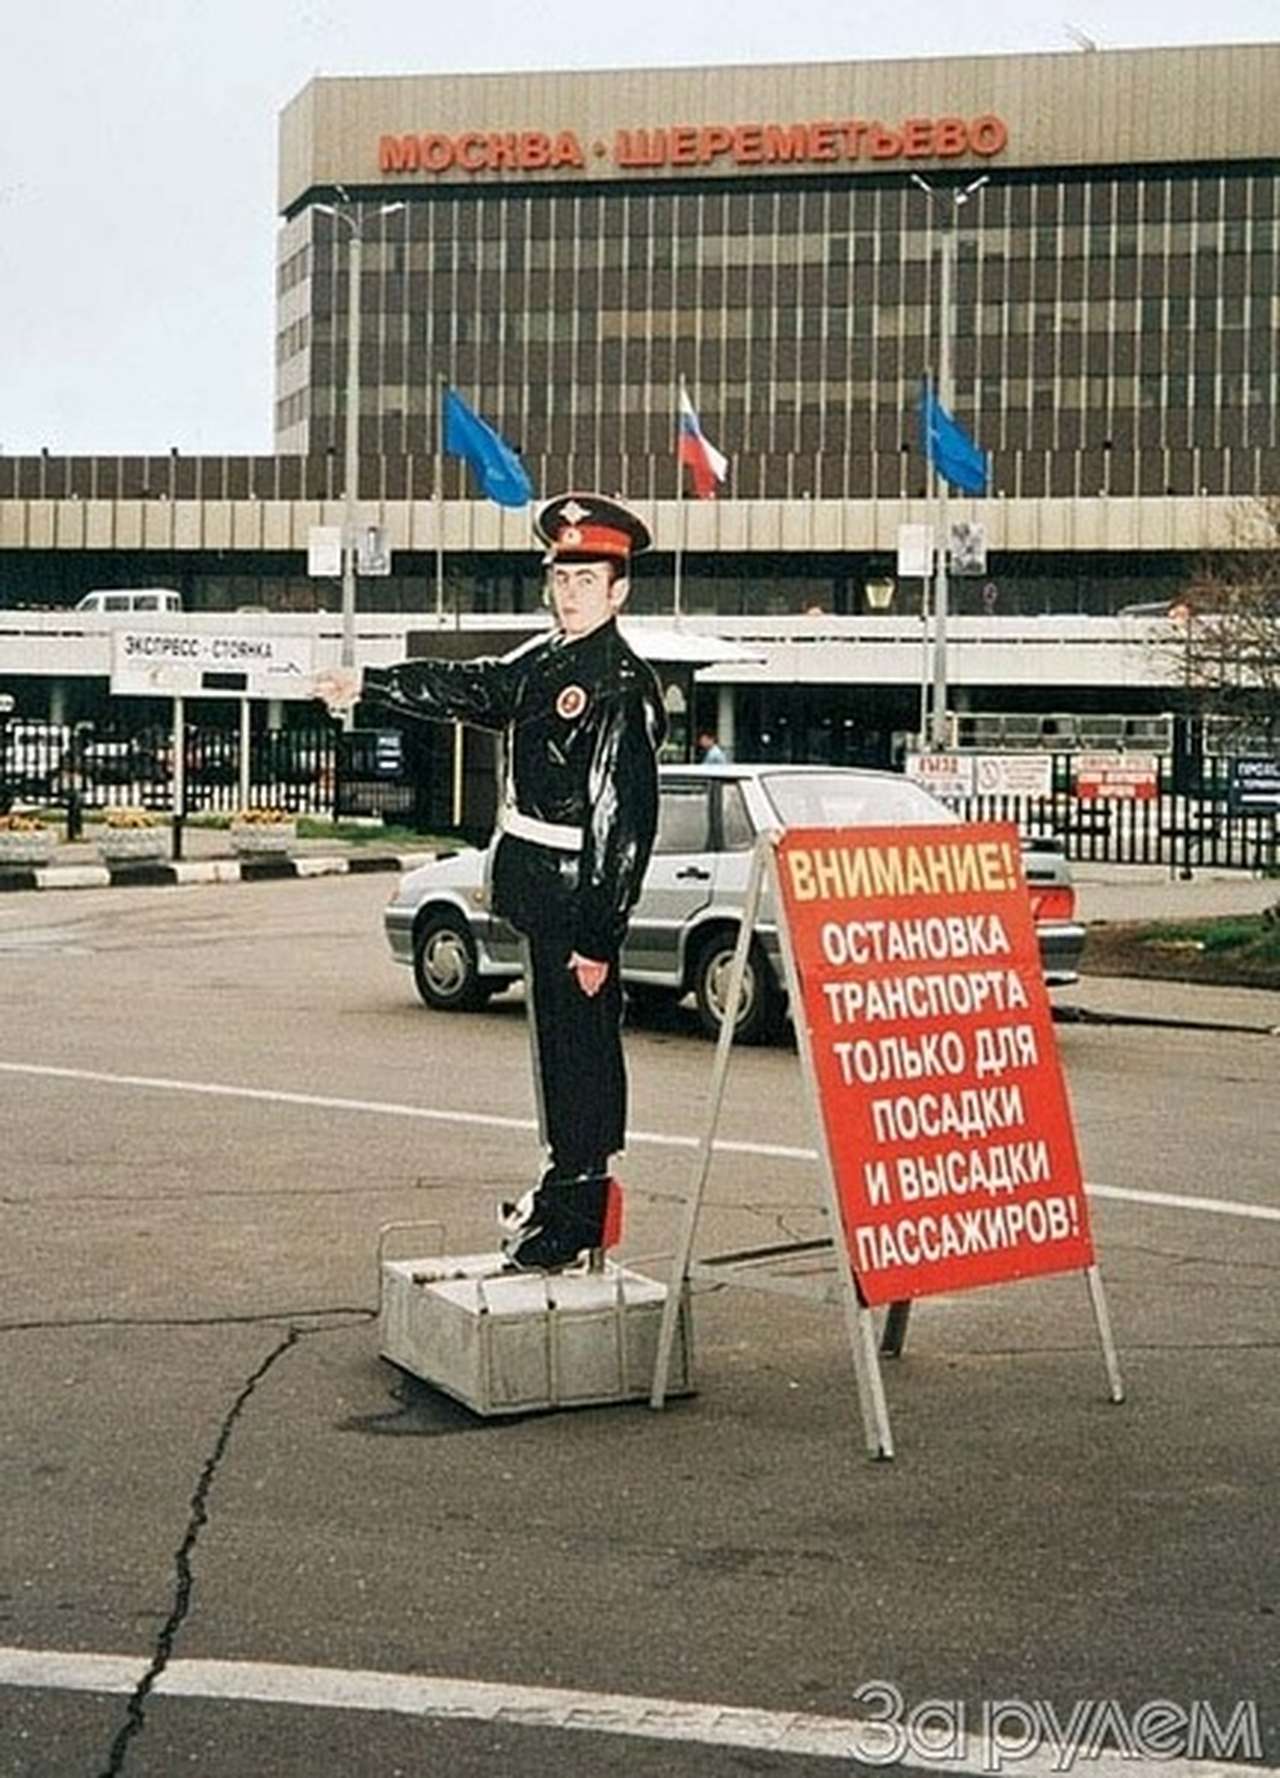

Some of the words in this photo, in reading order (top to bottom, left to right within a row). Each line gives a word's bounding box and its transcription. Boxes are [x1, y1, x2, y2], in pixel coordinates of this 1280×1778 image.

[379, 131, 583, 171] МОСКВА
[616, 115, 1008, 166] ШЕРЕМЕТЬЕВО
[125, 636, 199, 656] ЭКСПРЕСС
[789, 844, 1017, 901] ВНИМАНИЕ!
[822, 915, 1010, 964] ОСТАНОВКА
[823, 970, 1028, 1024] ТРАНСПОРТА
[833, 1029, 965, 1085] ТОЛЬКО
[975, 1024, 1038, 1078] ДЛЯ
[872, 1085, 1024, 1142] ПОСАДКИ
[864, 1161, 891, 1206] И
[897, 1141, 1050, 1197] ВЫСАДКИ
[855, 1196, 1079, 1272] ПАССАЖИРОВ!
